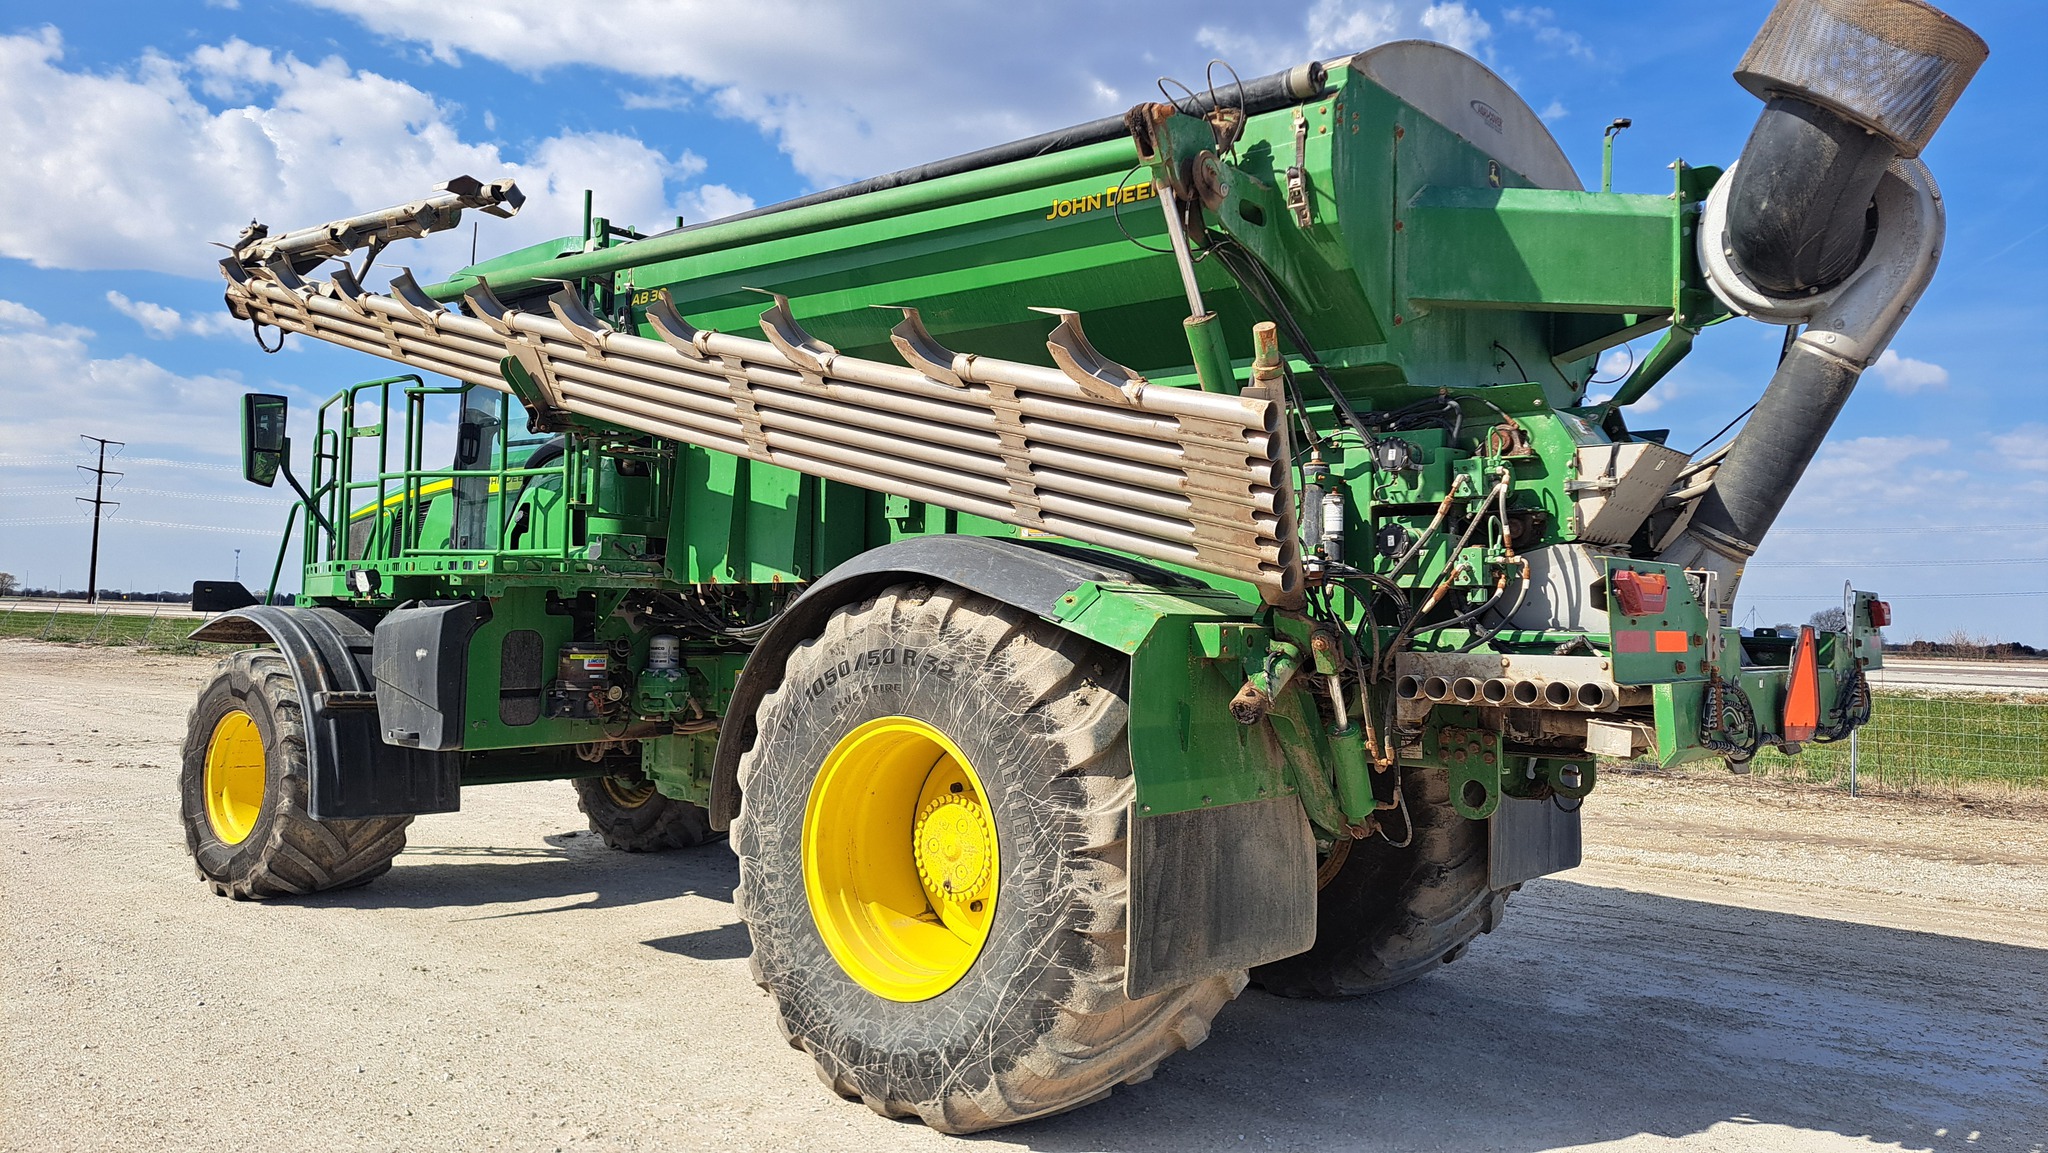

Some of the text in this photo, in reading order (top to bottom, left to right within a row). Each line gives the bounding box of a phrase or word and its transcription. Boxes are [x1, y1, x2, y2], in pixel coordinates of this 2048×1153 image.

[1046, 181, 1157, 221] JOHN DEE
[631, 291, 649, 306] AB
[805, 648, 896, 701] 1050/50
